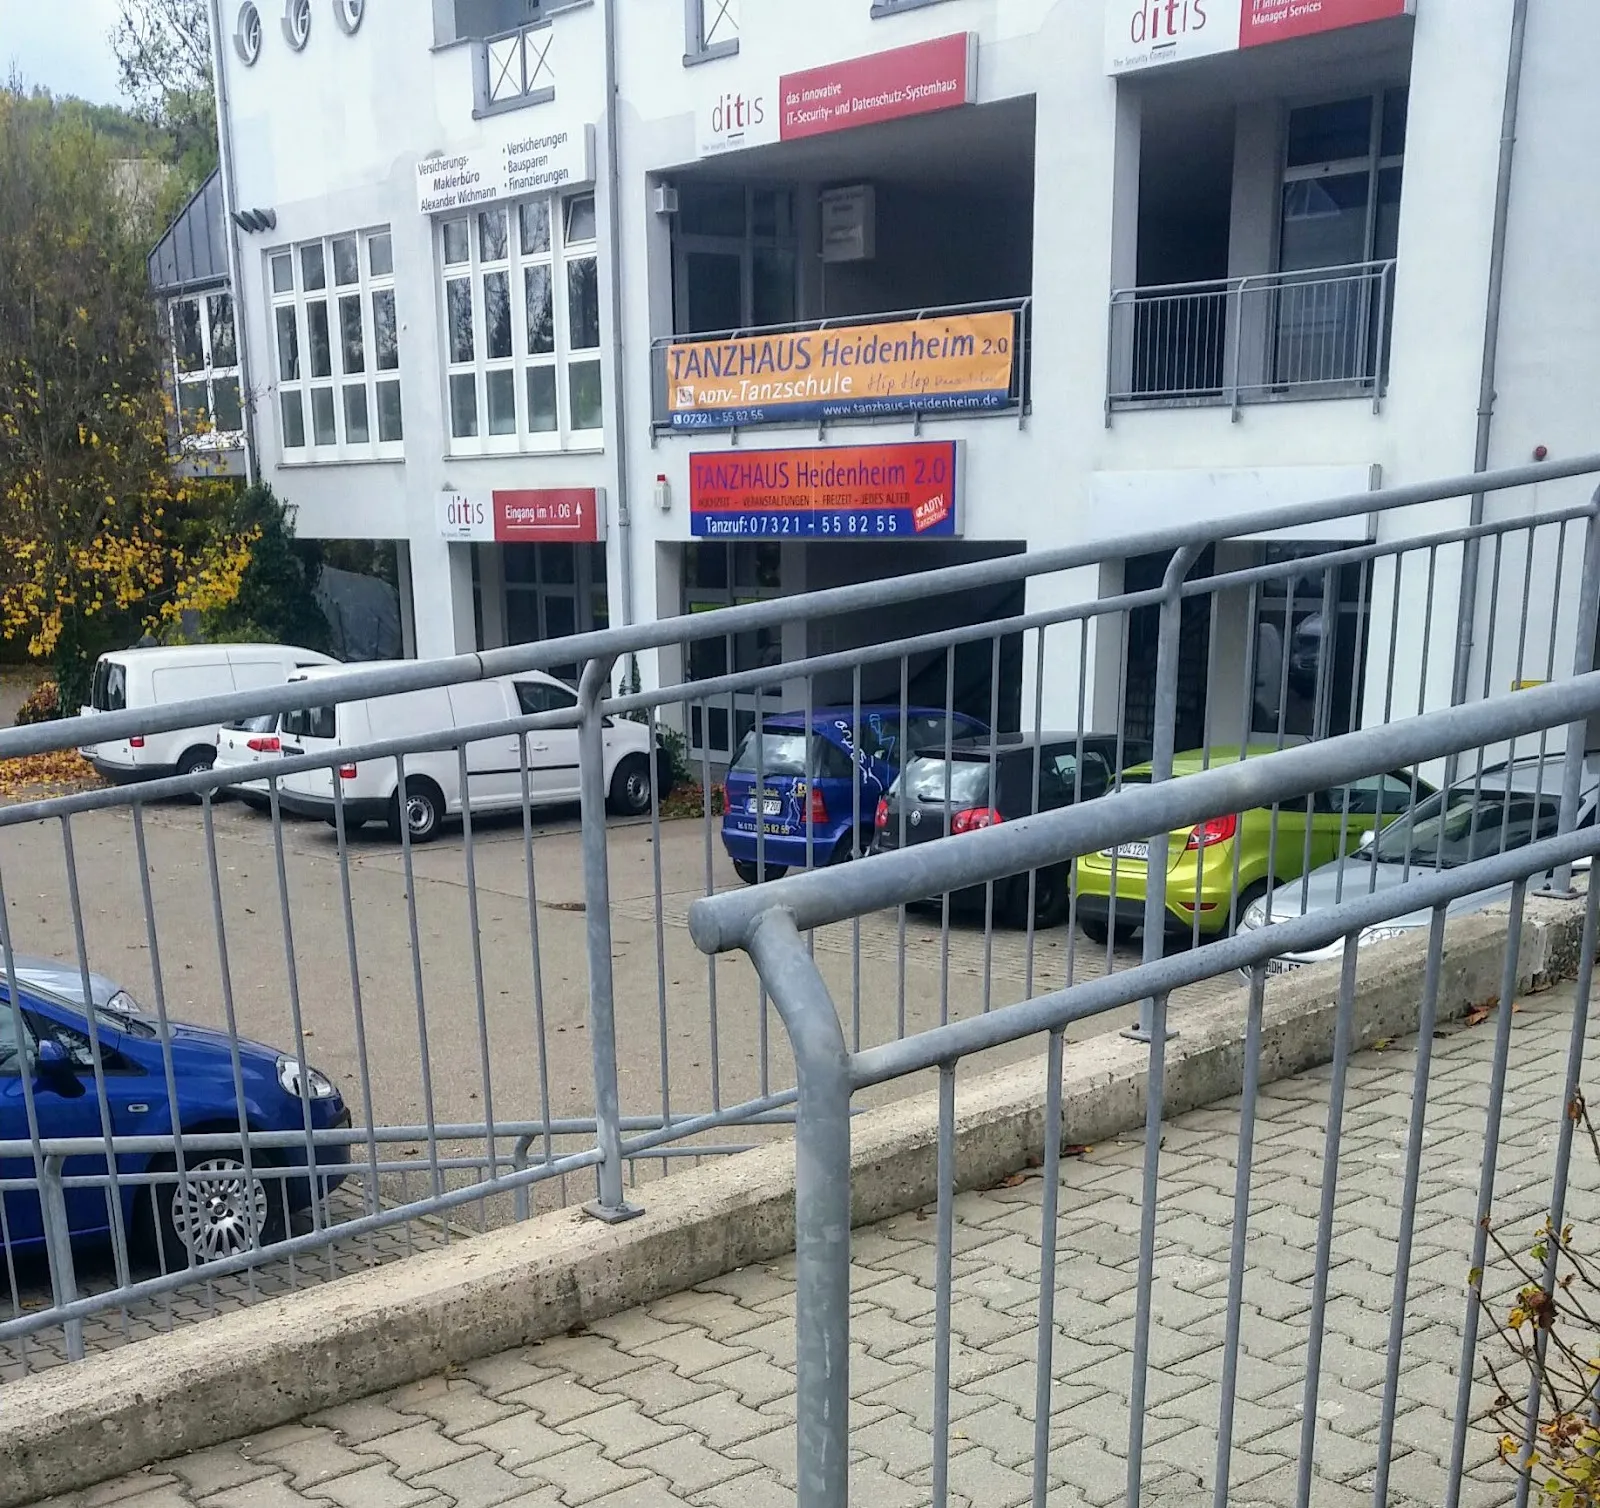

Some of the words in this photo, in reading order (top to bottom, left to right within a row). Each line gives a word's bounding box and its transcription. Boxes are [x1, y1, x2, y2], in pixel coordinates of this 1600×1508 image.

[1131, 0, 1206, 43] ditis
[1252, 6, 1288, 25] Managed
[1289, 2, 1322, 18] Services
[786, 91, 800, 105] das
[802, 82, 842, 101] innovative
[787, 102, 833, 125] IT-Security-
[835, 102, 850, 115] und
[852, 79, 958, 112] Datenschutz-Systemhaus
[712, 93, 764, 133] ditis
[507, 131, 568, 155] Versicherungen
[418, 154, 469, 175] Versicherungs-
[508, 154, 548, 174] Bausparen
[433, 171, 480, 191] Maklerbüro
[509, 167, 569, 190] Finanzierungen
[421, 194, 456, 211] Alexander
[457, 186, 496, 205] Wichmann
[671, 336, 811, 380] TANZHAUS
[821, 327, 975, 368] Heidenheim
[981, 337, 1008, 356] 2.0
[698, 371, 853, 404] ADTV-Tanzschule
[868, 373, 895, 396] Hip
[901, 370, 930, 393] Hop
[823, 394, 999, 416] www.tanzhaus-heidenheim.de
[683, 412, 712, 424] 07321
[695, 461, 790, 490] TANZHAUS
[797, 458, 906, 488] Heidenheim
[914, 457, 946, 485] 2.0
[447, 495, 484, 525] ditis
[743, 494, 810, 507] VERANSTALTUNGEN
[822, 493, 852, 506] FREIZEIT
[861, 493, 883, 505] JEDES
[885, 491, 911, 504] ALTER
[505, 504, 535, 523] Eingang
[536, 504, 547, 518] im
[549, 505, 557, 518] 1.
[558, 503, 571, 518] OG
[705, 515, 748, 533] Tanzruf:
[750, 516, 800, 533] 07321
[822, 515, 841, 533] 55
[848, 515, 868, 533] 82
[876, 514, 897, 532] 55
